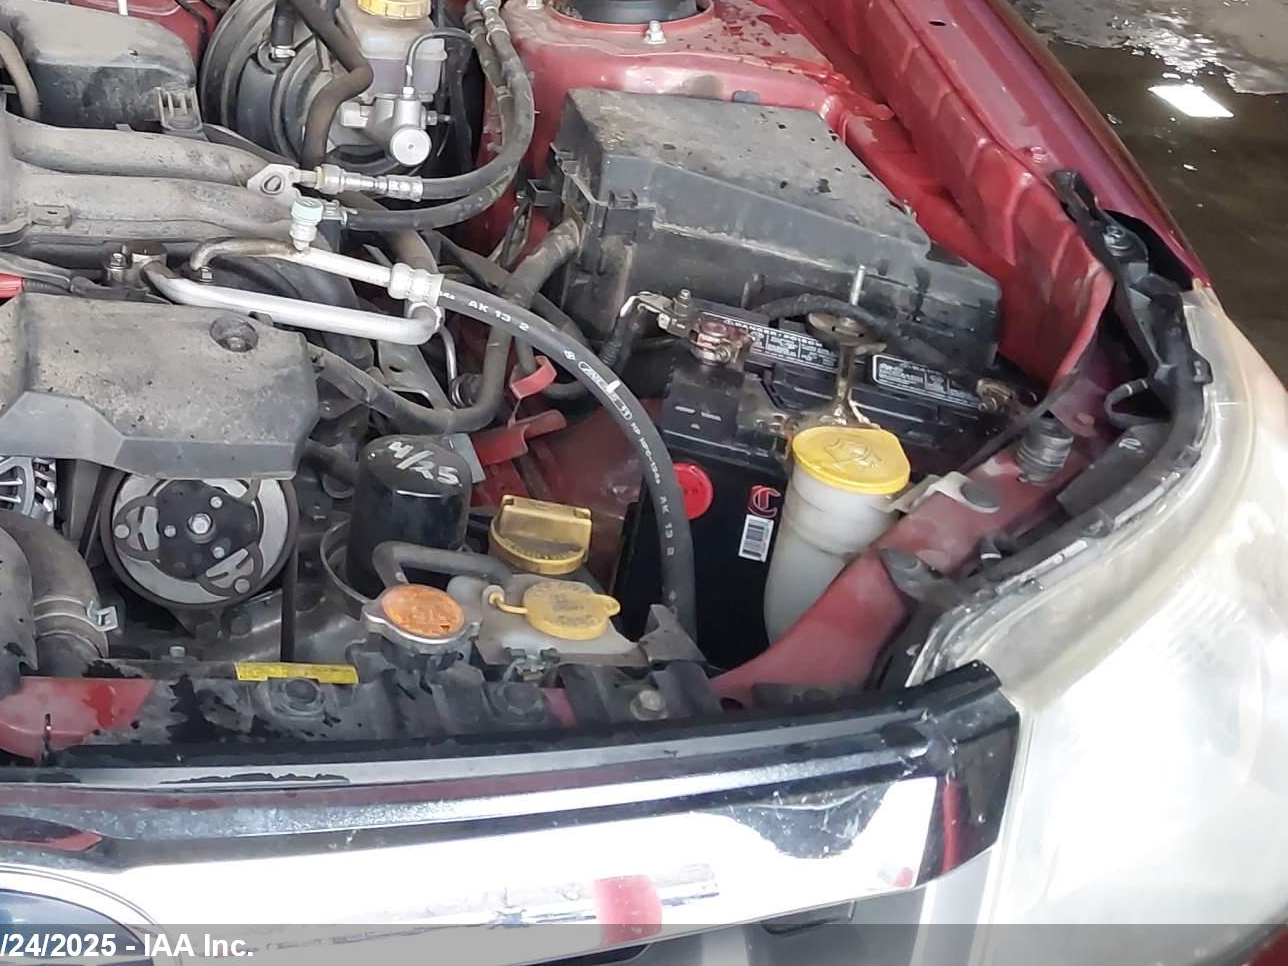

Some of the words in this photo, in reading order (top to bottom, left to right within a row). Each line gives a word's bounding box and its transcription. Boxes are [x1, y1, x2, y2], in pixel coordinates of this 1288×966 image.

[468, 300, 489, 313] AK
[494, 310, 512, 323] 13
[518, 322, 530, 332] 2
